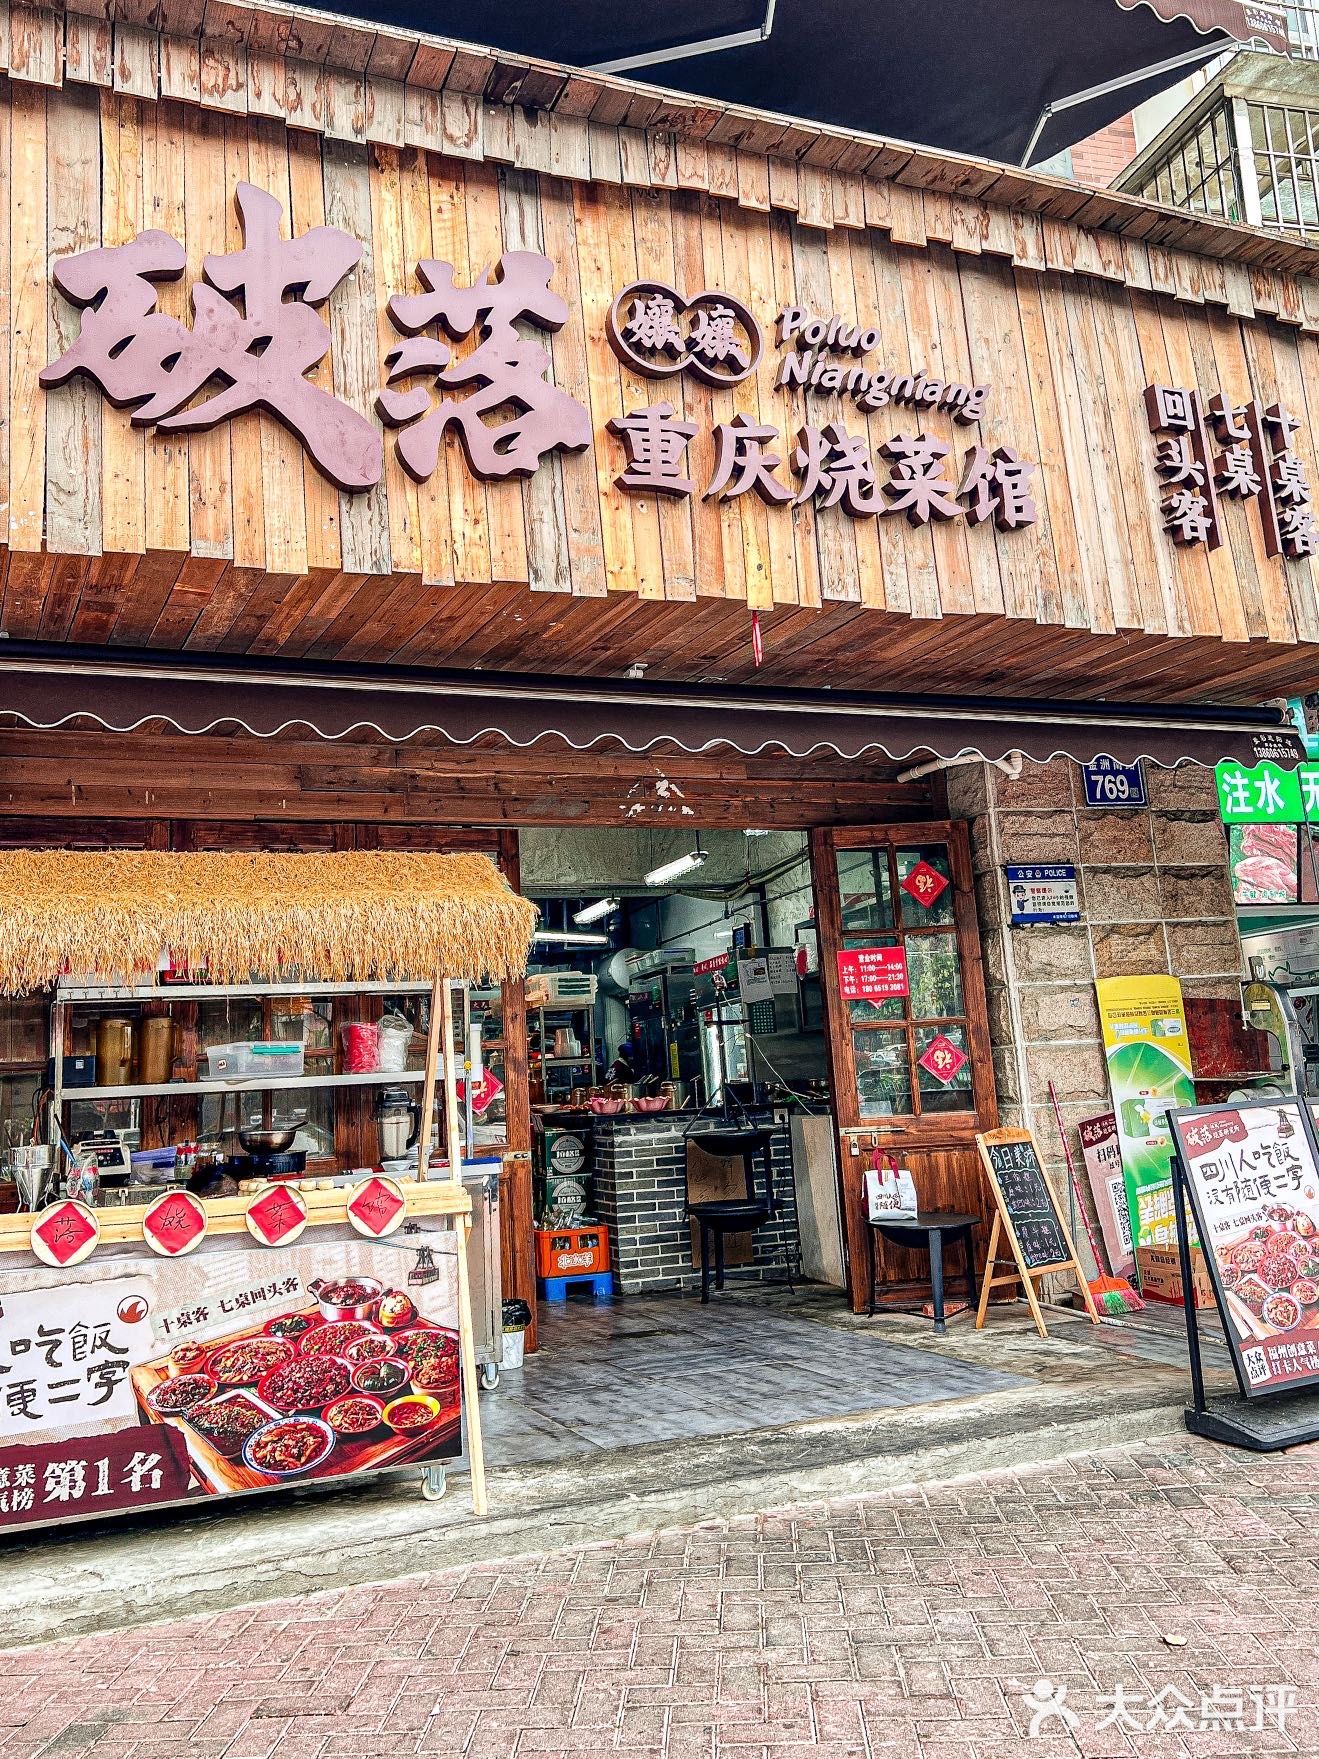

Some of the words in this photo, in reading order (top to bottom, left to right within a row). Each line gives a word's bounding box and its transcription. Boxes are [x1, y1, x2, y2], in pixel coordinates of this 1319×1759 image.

[777, 306, 882, 357] Poluo
[776, 351, 991, 425] Niangniang
[605, 402, 1037, 531] 重庆烧菜馆
[1144, 384, 1212, 545] 回头客
[1263, 403, 1319, 559] 十桌客
[1091, 775, 1129, 799] 769
[1222, 769, 1285, 815] 注水
[1017, 869, 1033, 878] 公安
[1044, 869, 1067, 877] POLICE
[159, 1306, 209, 1334] 十桌客
[217, 1277, 299, 1314] 七桌回头客
[0, 1321, 130, 1374] 吃飯
[43, 1452, 163, 1504] 第1名
